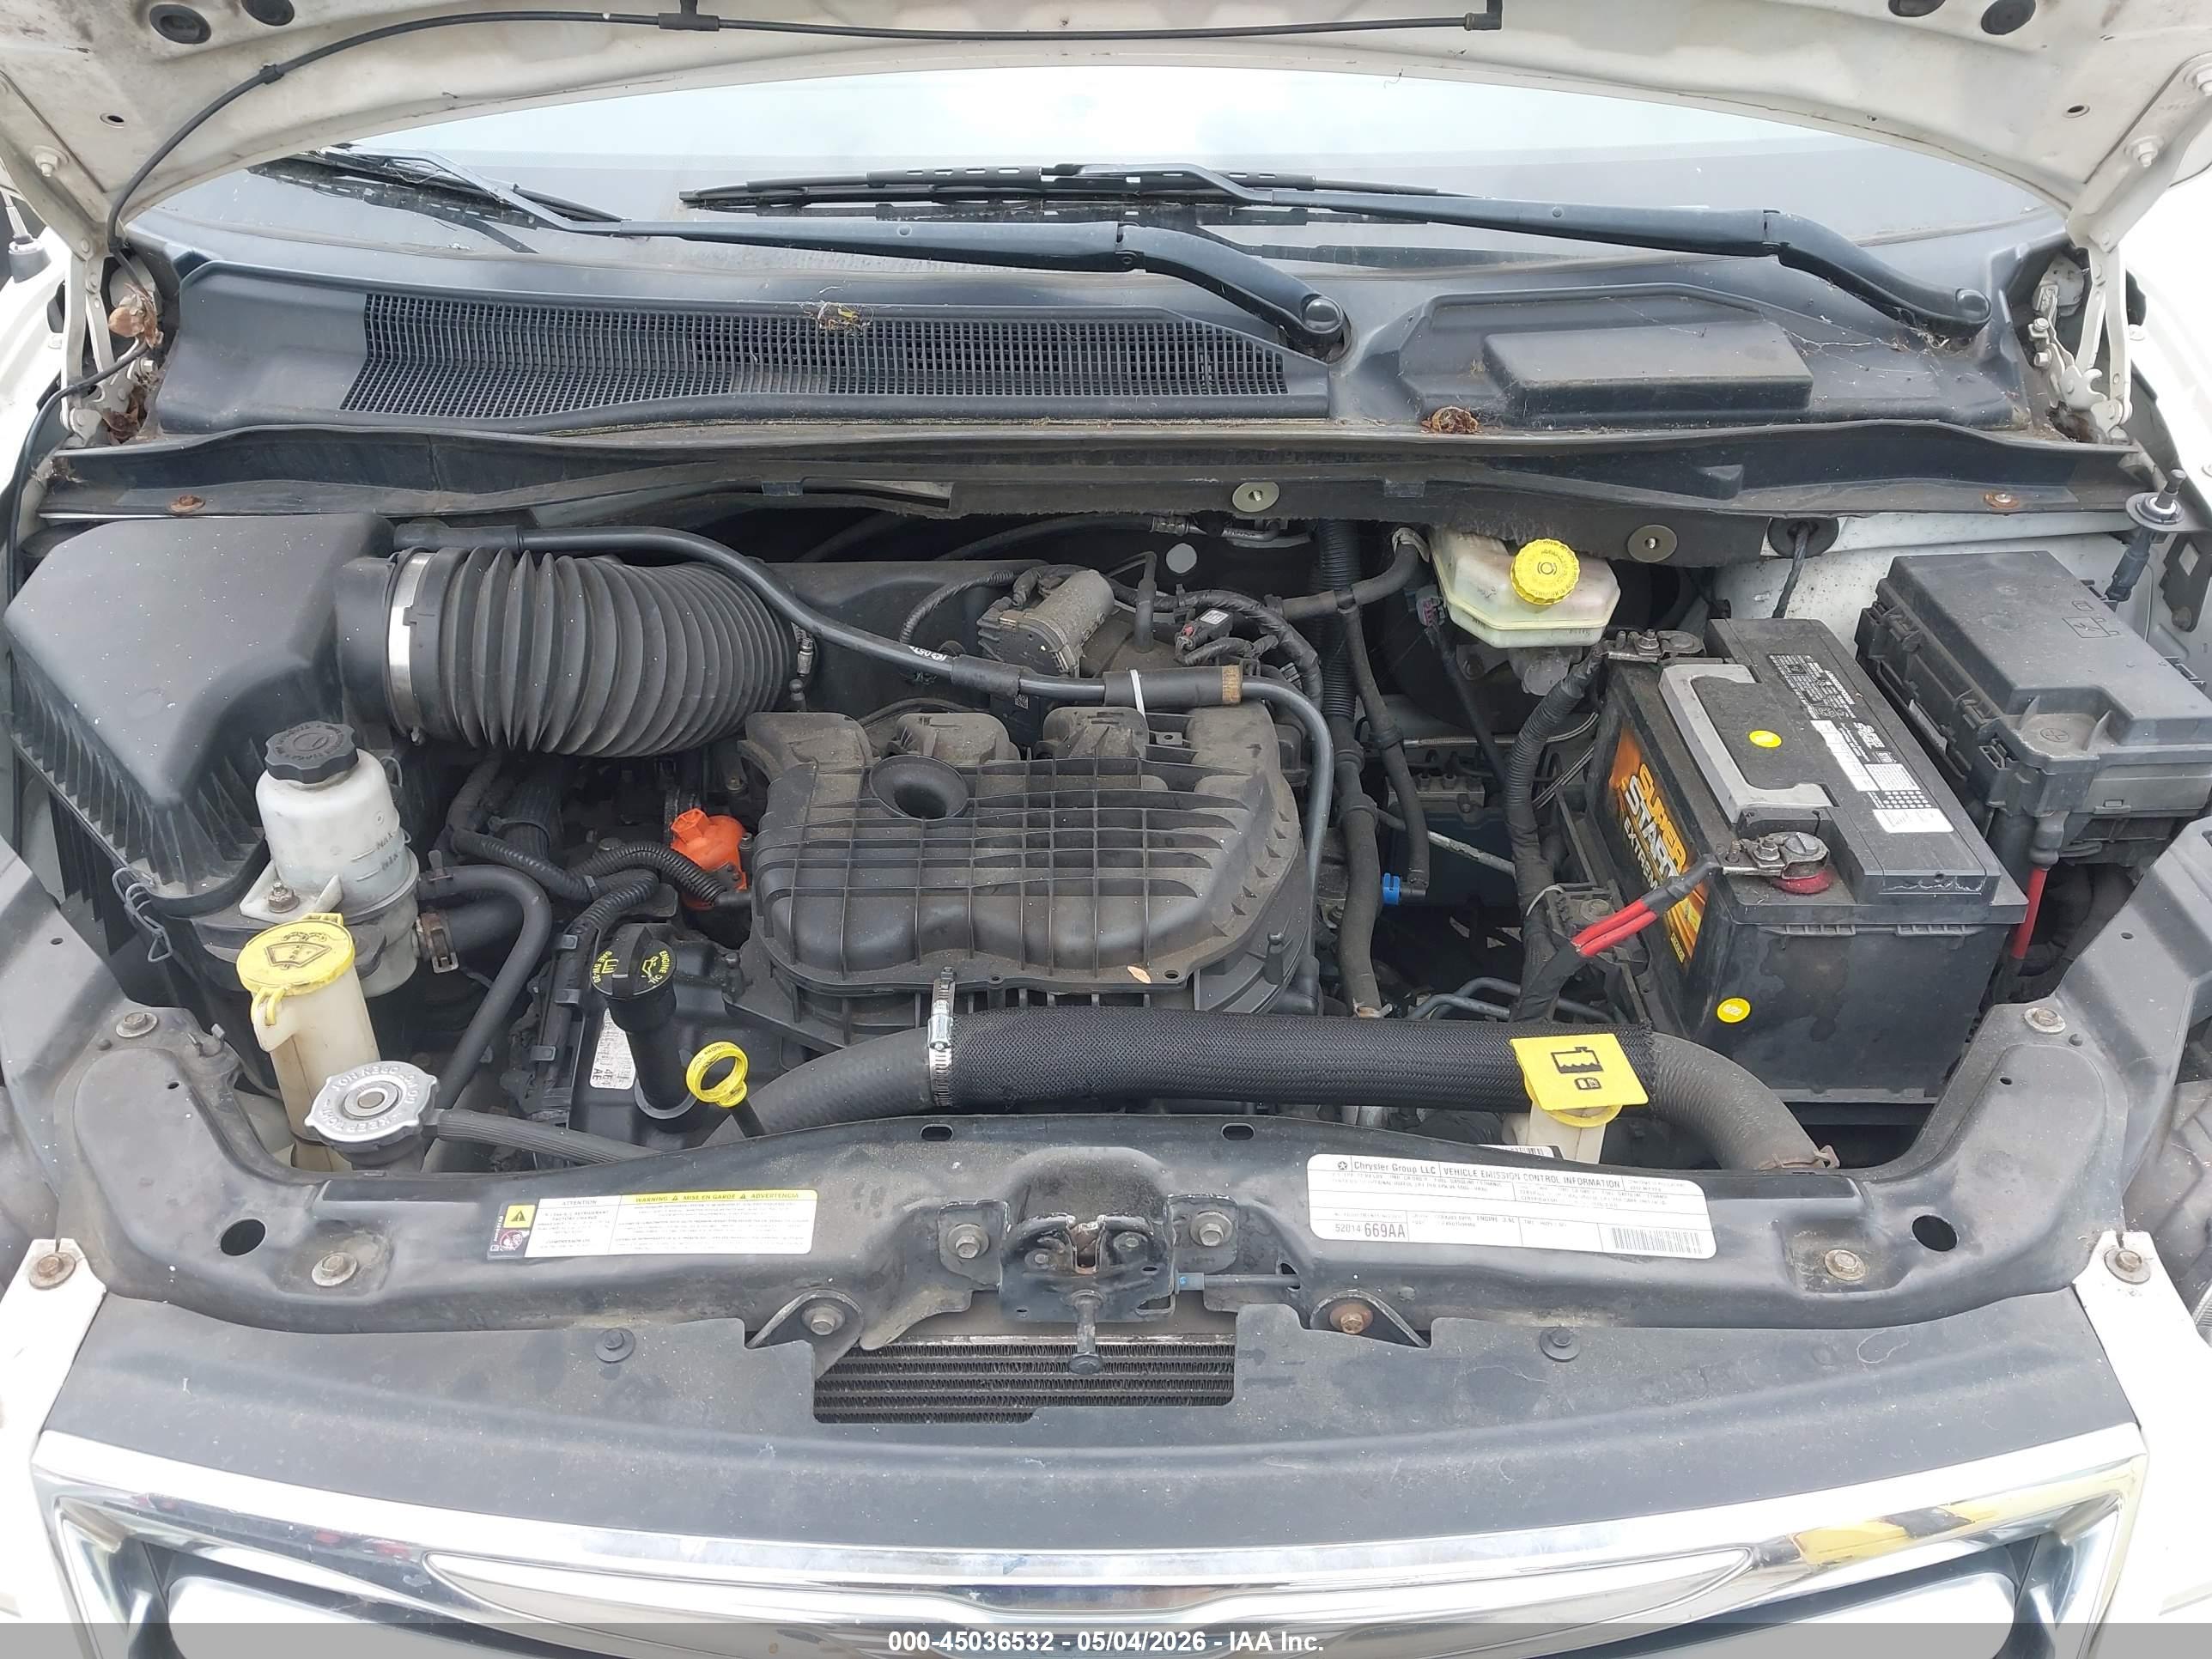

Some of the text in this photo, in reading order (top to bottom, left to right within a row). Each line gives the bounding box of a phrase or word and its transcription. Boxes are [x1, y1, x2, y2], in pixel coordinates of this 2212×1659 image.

[1625, 775, 1680, 881] START
[1639, 763, 1686, 873] SUPER
[647, 950, 670, 984] ENGINE OIL
[1354, 1161, 1436, 1175] Chrysler Group LLC
[1443, 1167, 1478, 1177] VEHICLE
[1480, 1170, 1521, 1181] EMISSION
[1523, 1173, 1561, 1184] CONTROL
[1564, 1176, 1620, 1188] INFORMATION
[1334, 1223, 1407, 1238] 52014 669AA
